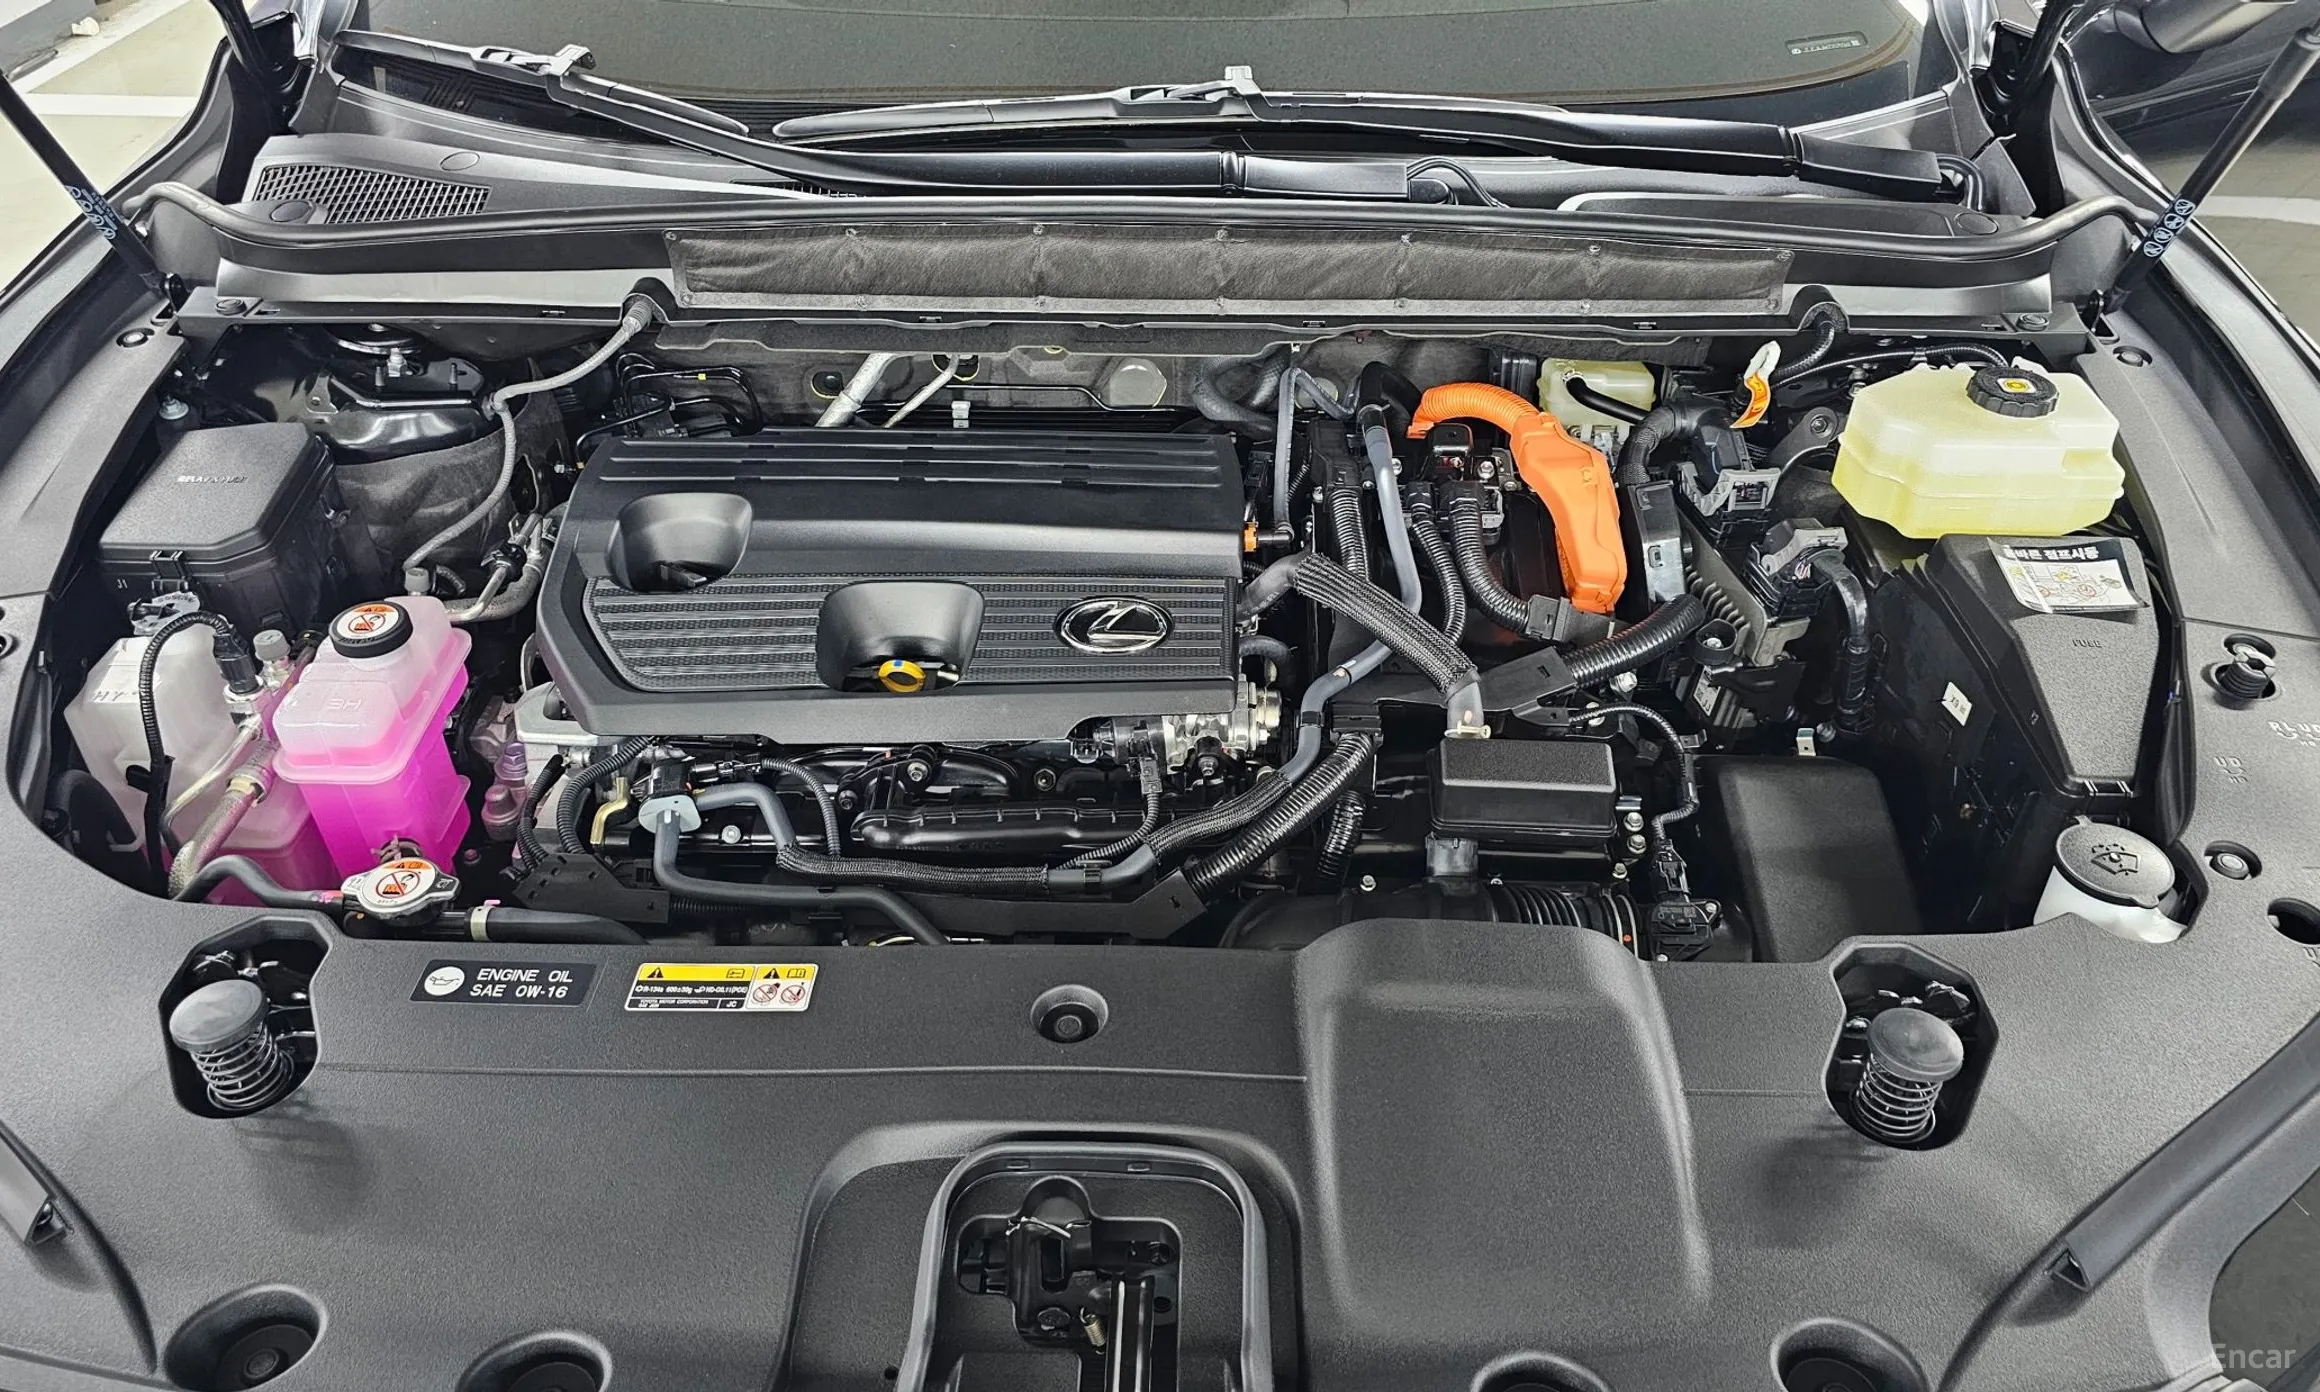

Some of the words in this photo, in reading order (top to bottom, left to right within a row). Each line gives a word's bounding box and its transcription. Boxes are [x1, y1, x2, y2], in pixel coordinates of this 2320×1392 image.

[476, 968, 540, 983] ENGINE
[548, 970, 573, 983] OIL
[469, 984, 507, 997] SAE
[515, 985, 569, 999] 0W-16
